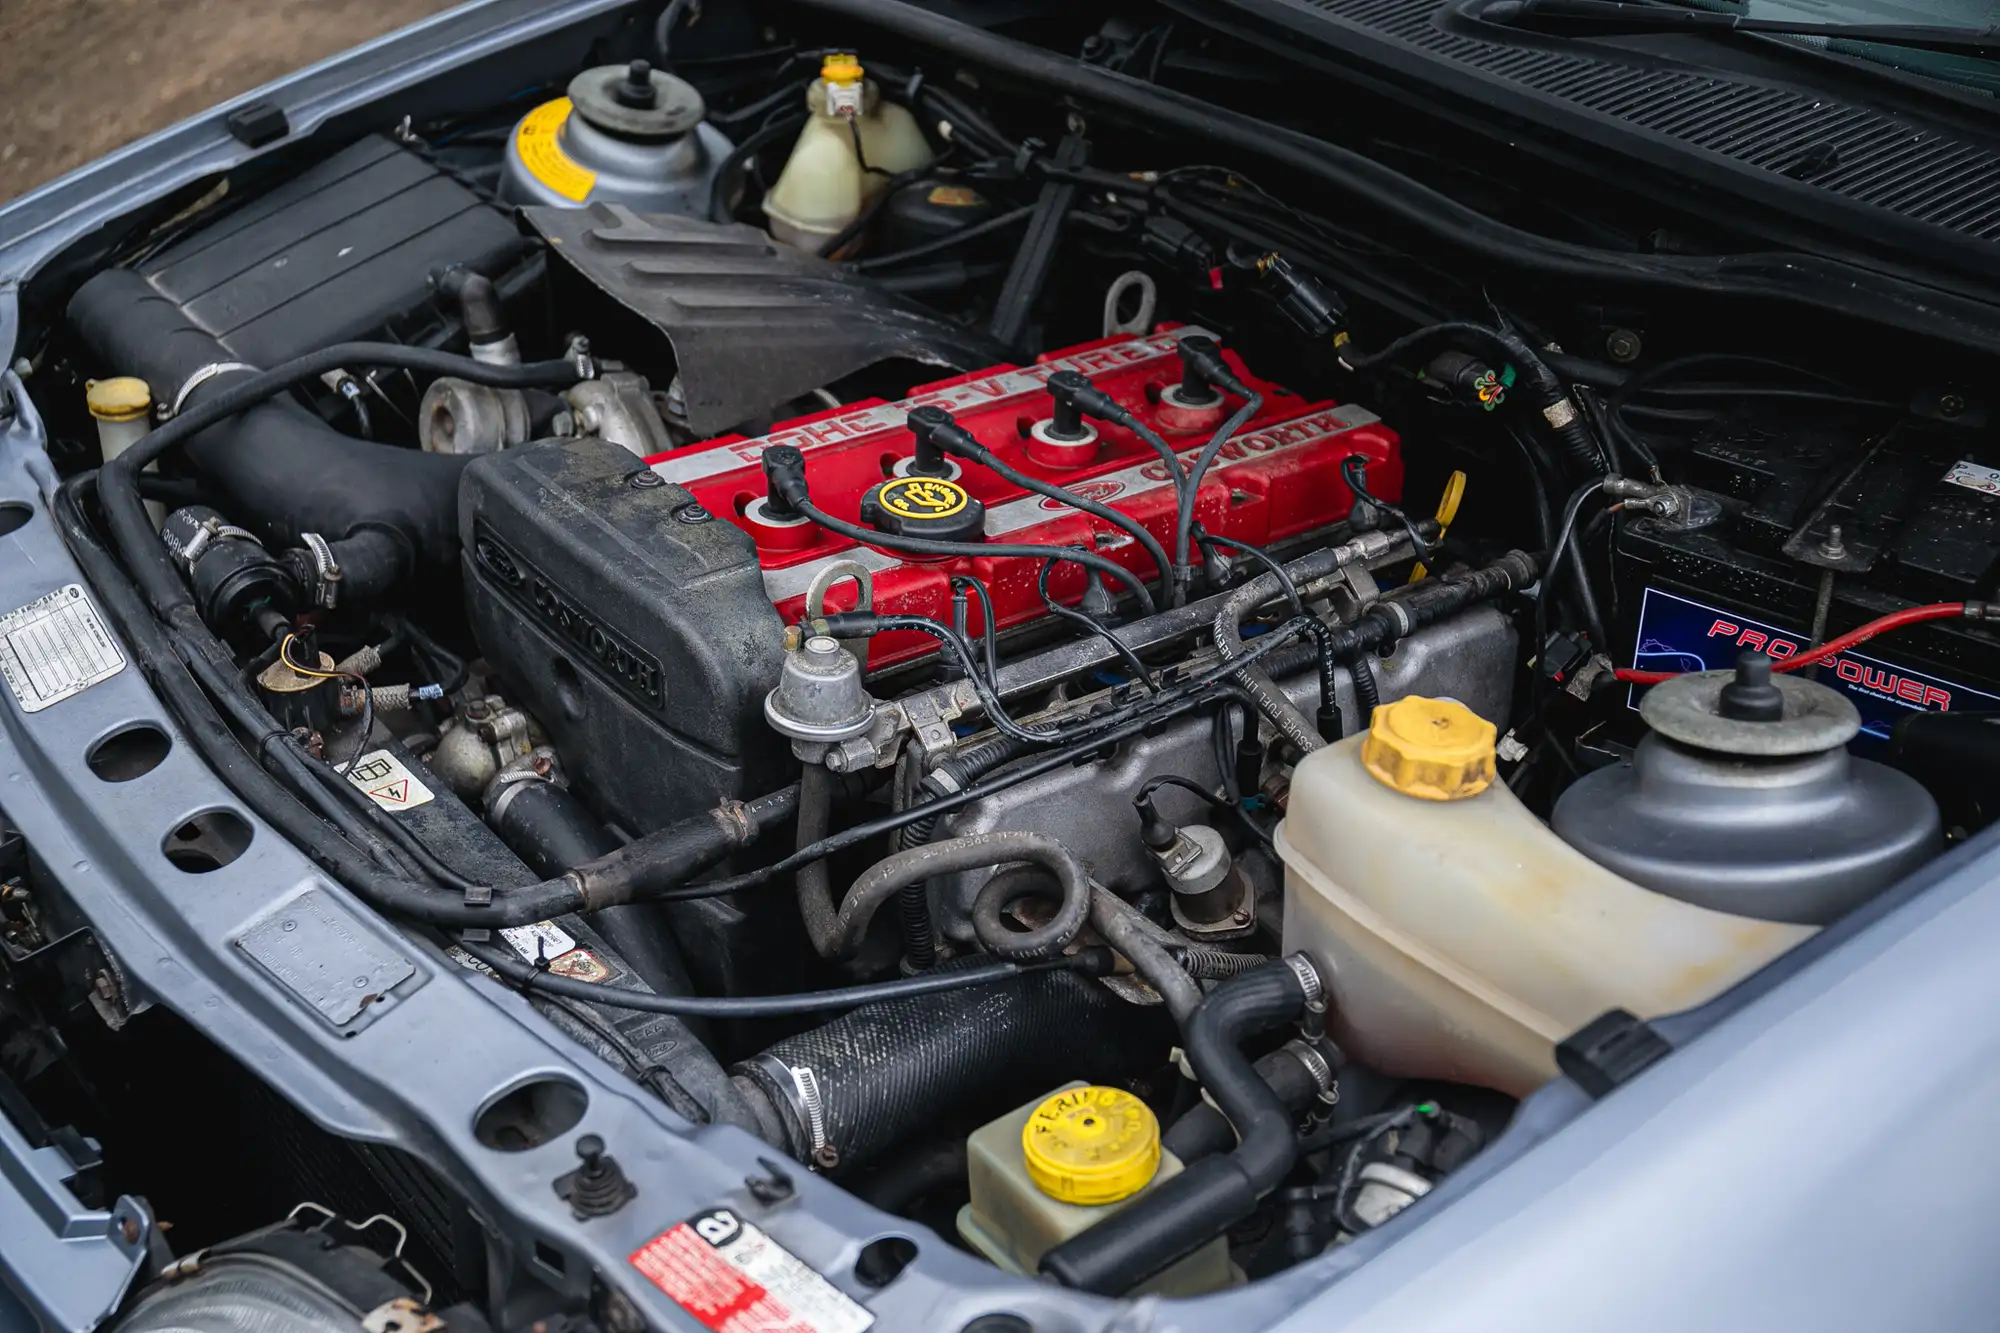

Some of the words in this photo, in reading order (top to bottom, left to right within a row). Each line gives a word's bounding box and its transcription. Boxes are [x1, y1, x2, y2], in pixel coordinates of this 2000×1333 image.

[1140, 412, 1351, 482] COWORTH
[1235, 667, 1259, 695] LINE
[1707, 619, 1798, 660] PRO
[1818, 655, 1952, 711] OWER
[1259, 691, 1283, 720] FUEL
